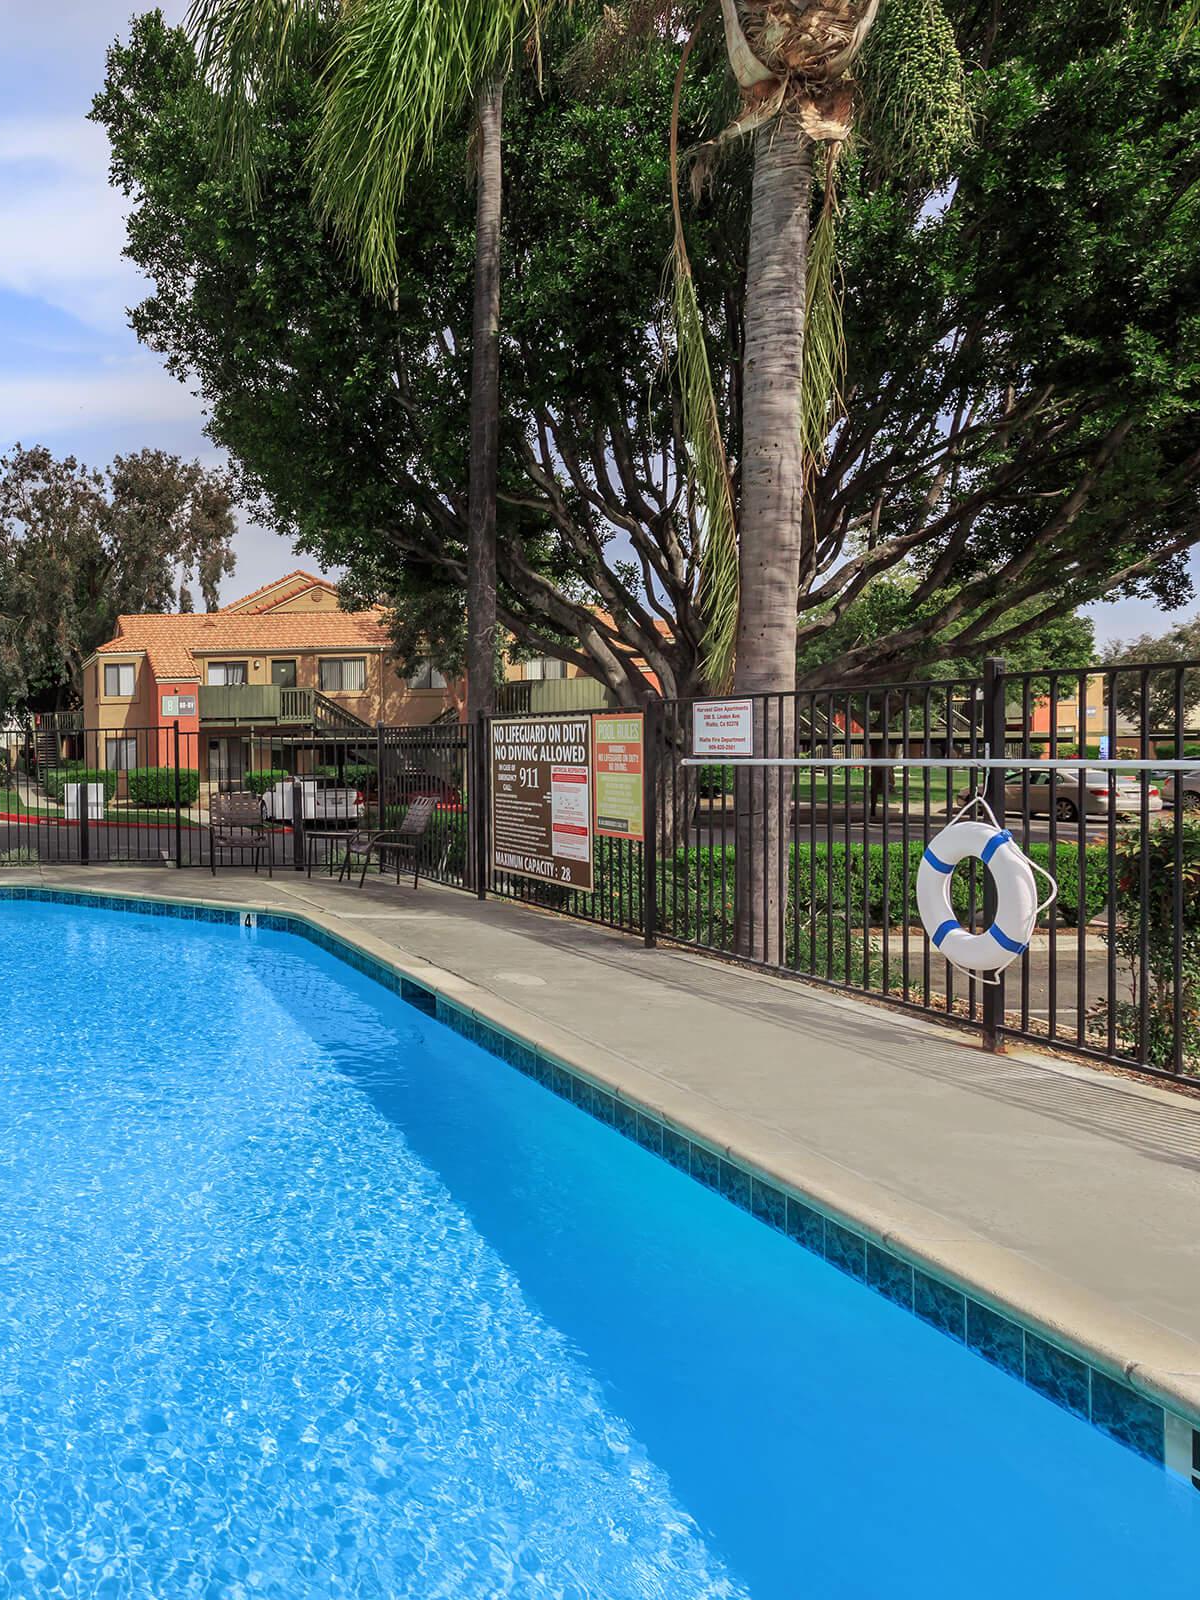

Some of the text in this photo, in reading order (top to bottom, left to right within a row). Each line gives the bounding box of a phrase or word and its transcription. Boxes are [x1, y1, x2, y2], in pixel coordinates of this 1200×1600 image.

[494, 723, 586, 743] NO LIFEGUARD ON DUTY
[495, 745, 585, 762] NO DIVING ALLOWED
[520, 768, 540, 788] 911
[496, 851, 523, 870] MAXIMUM
[561, 866, 571, 881] 28
[245, 914, 251, 928] 4
